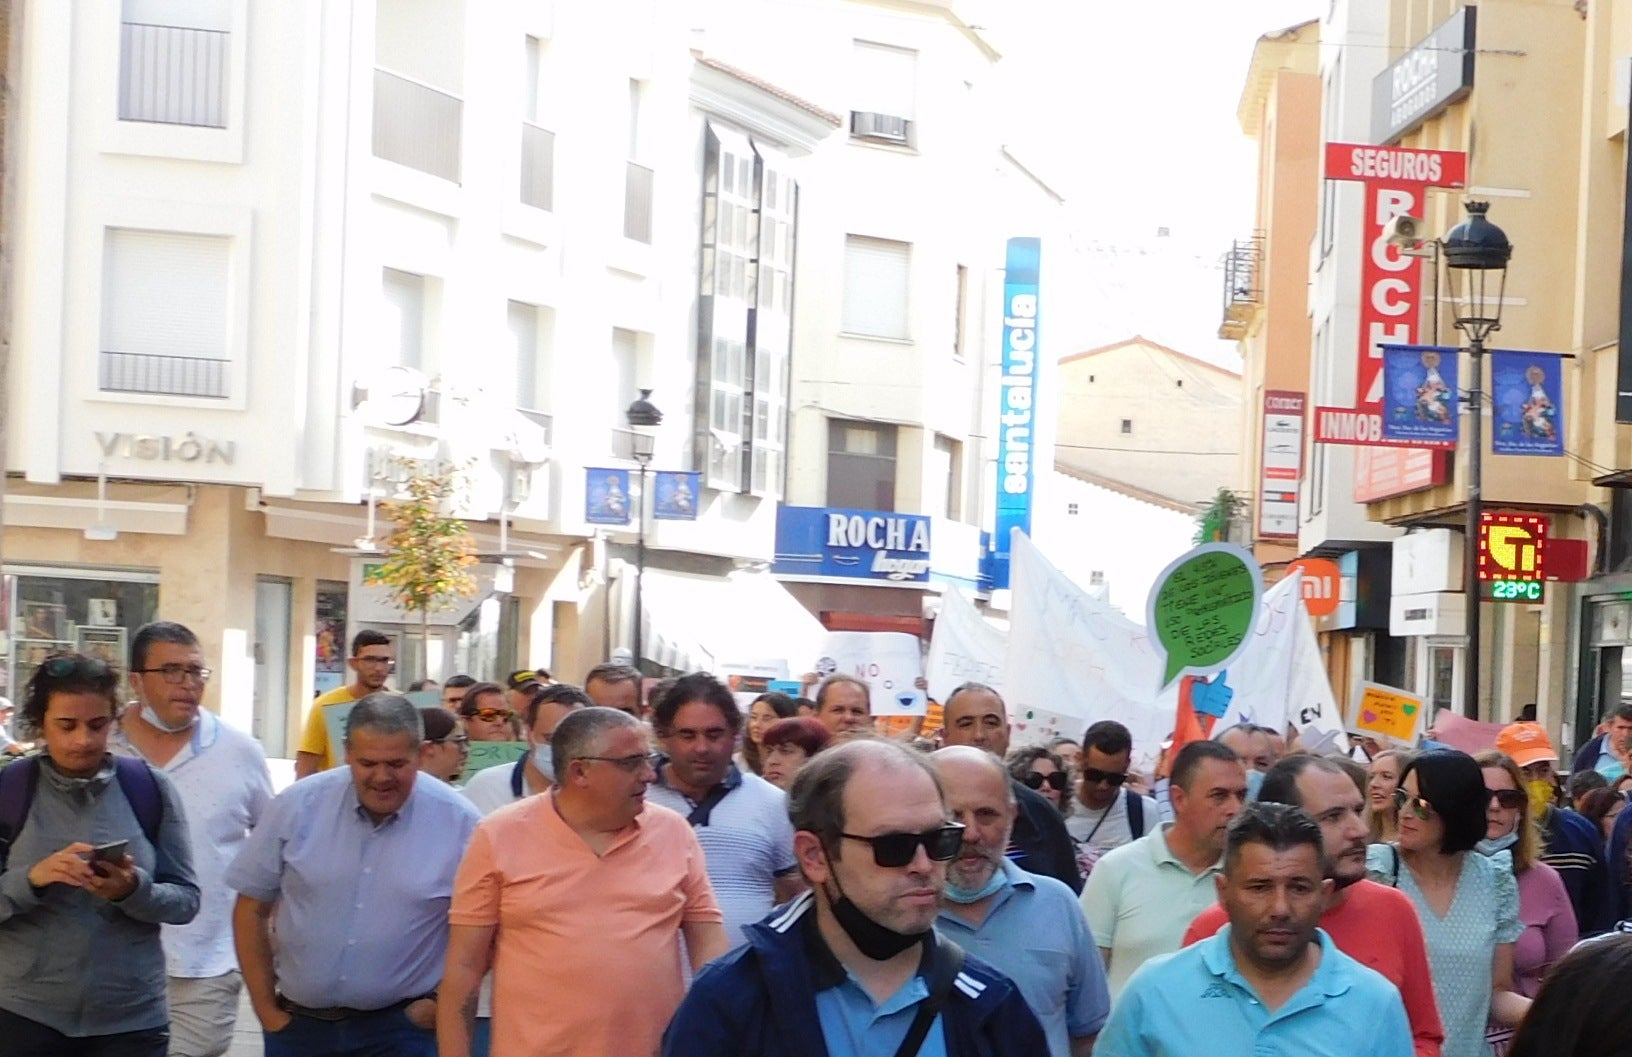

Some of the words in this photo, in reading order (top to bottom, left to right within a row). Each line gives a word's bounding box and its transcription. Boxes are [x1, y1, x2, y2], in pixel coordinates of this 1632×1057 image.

[1351, 148, 1443, 182] SEGUROS
[94, 430, 238, 466] VISIÓN
[827, 513, 930, 552] ROCHA
